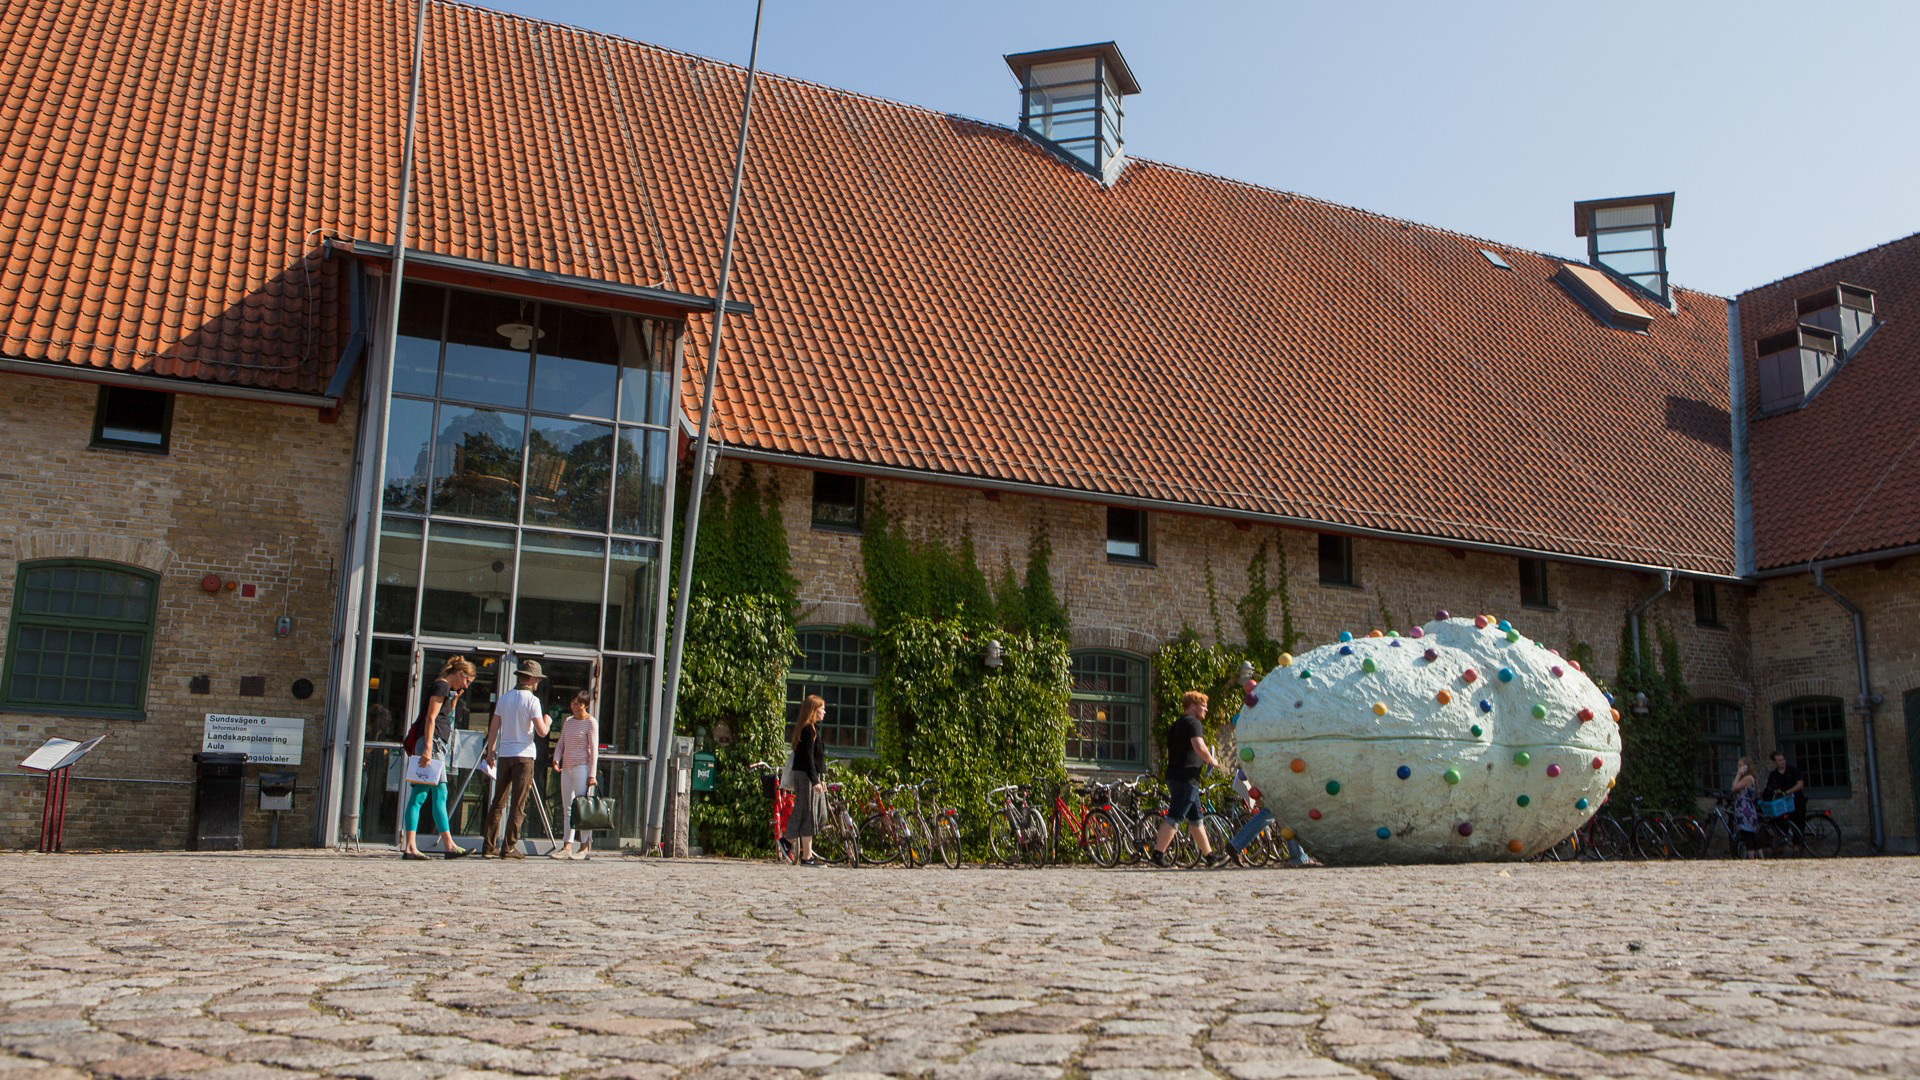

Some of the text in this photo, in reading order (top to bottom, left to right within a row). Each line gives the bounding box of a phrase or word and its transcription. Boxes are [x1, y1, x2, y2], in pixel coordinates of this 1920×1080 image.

[209, 715, 258, 725] Sundsvägen
[207, 733, 287, 744] Landskapsplanering
[207, 742, 225, 750] Aula
[248, 755, 289, 763] ngslokaler
[697, 769, 710, 778] POST
